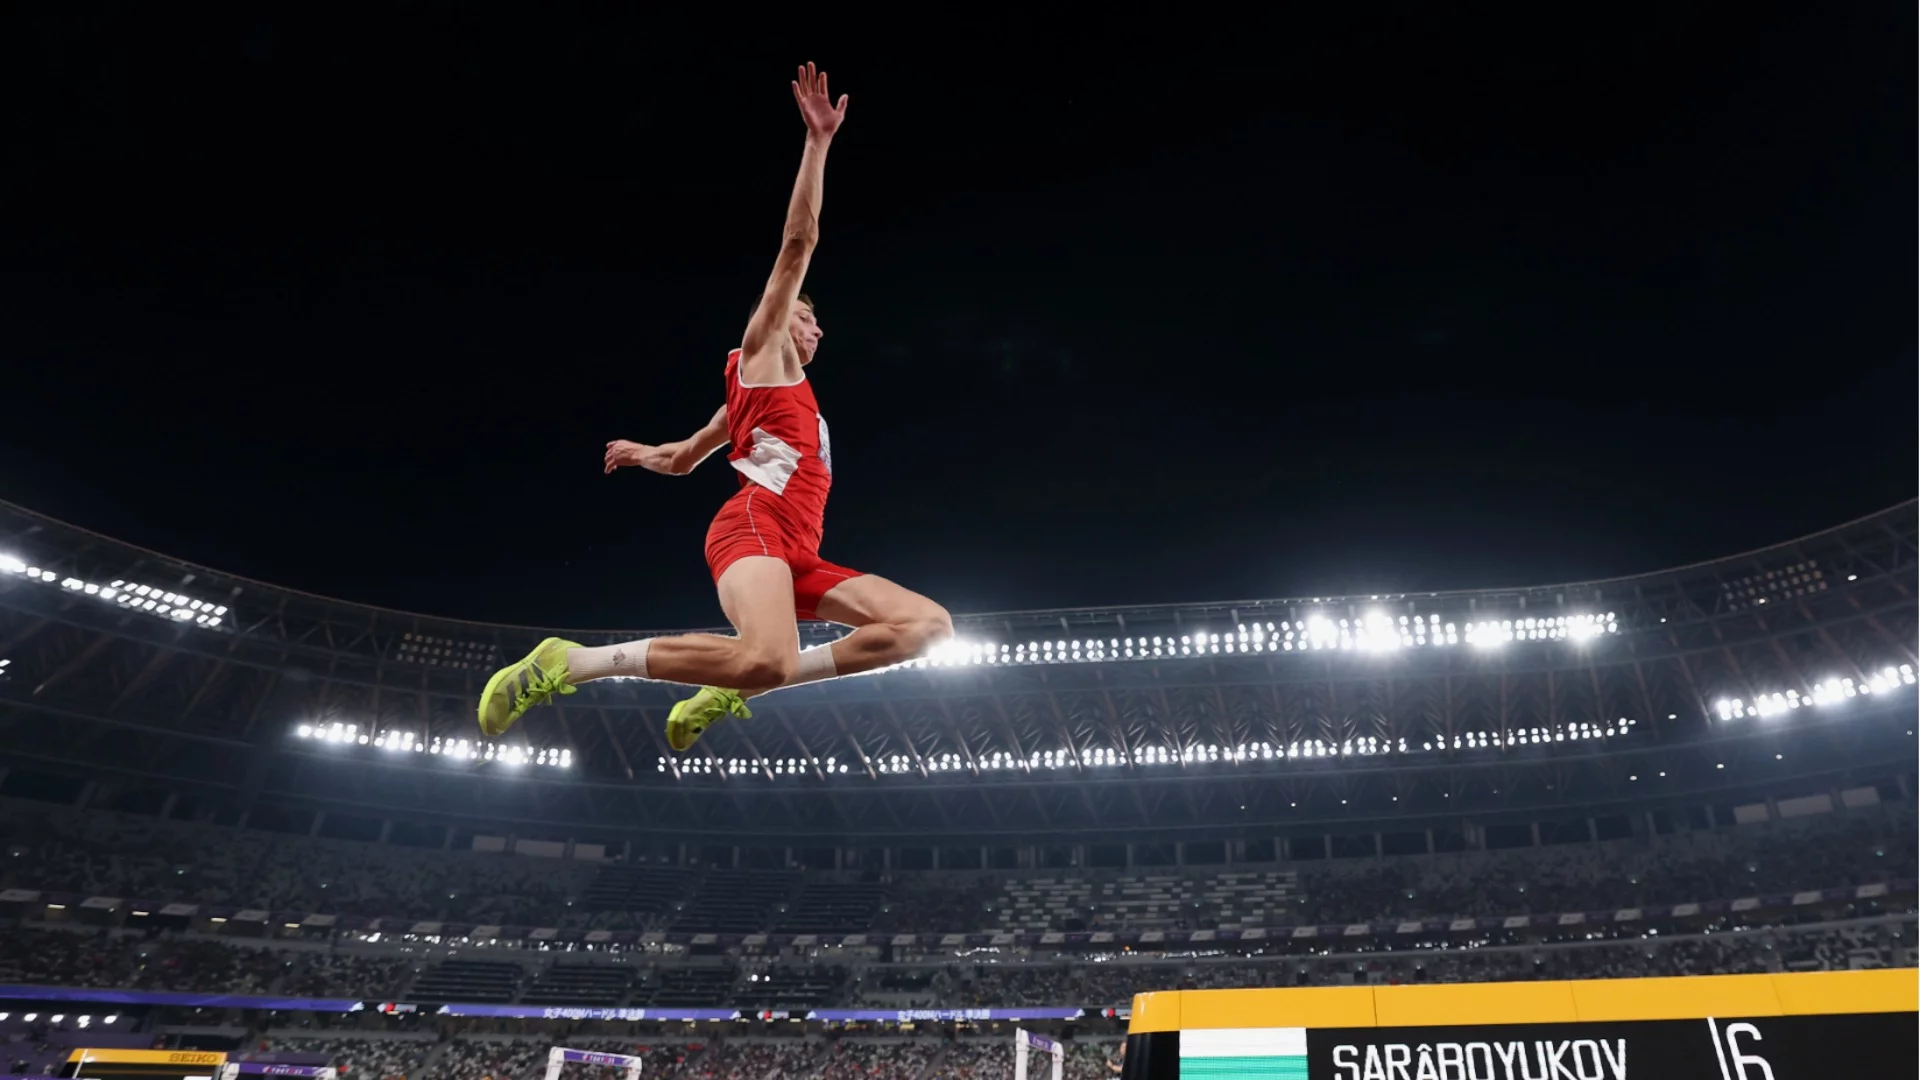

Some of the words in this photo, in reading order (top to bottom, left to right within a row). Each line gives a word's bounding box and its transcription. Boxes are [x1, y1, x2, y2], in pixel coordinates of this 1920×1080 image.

[168, 1052, 218, 1063] SEIKO
[1332, 1038, 1626, 1080] SARÂBOYUKOV
[1726, 1022, 1775, 1080] 6
